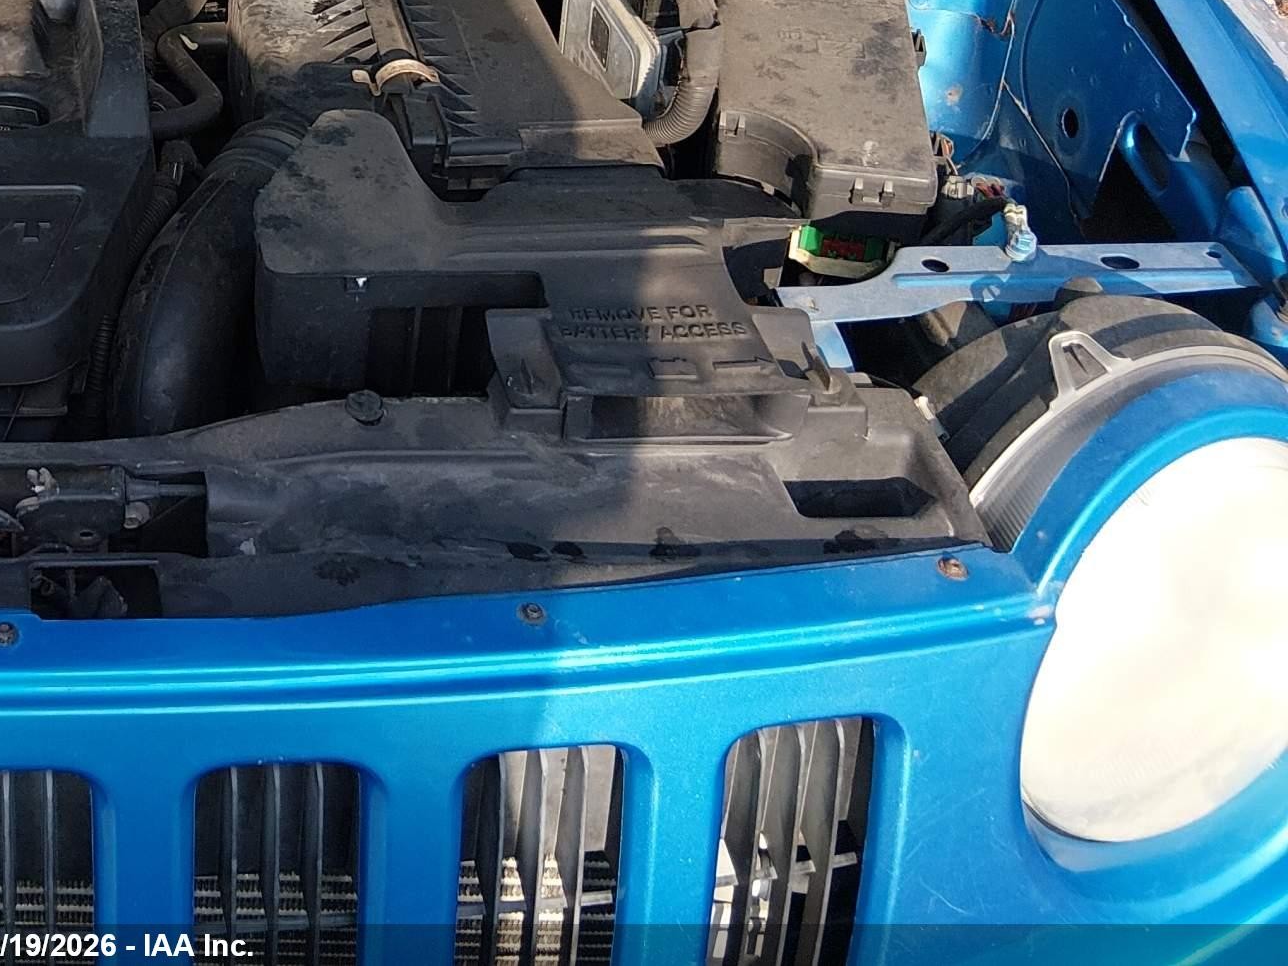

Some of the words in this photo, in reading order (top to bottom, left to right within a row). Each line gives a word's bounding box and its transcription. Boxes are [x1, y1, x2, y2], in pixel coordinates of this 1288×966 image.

[569, 305, 662, 322] REMOVE
[665, 304, 714, 321] FOR
[559, 324, 651, 341] BATTERY
[660, 320, 748, 341] ACCESS
